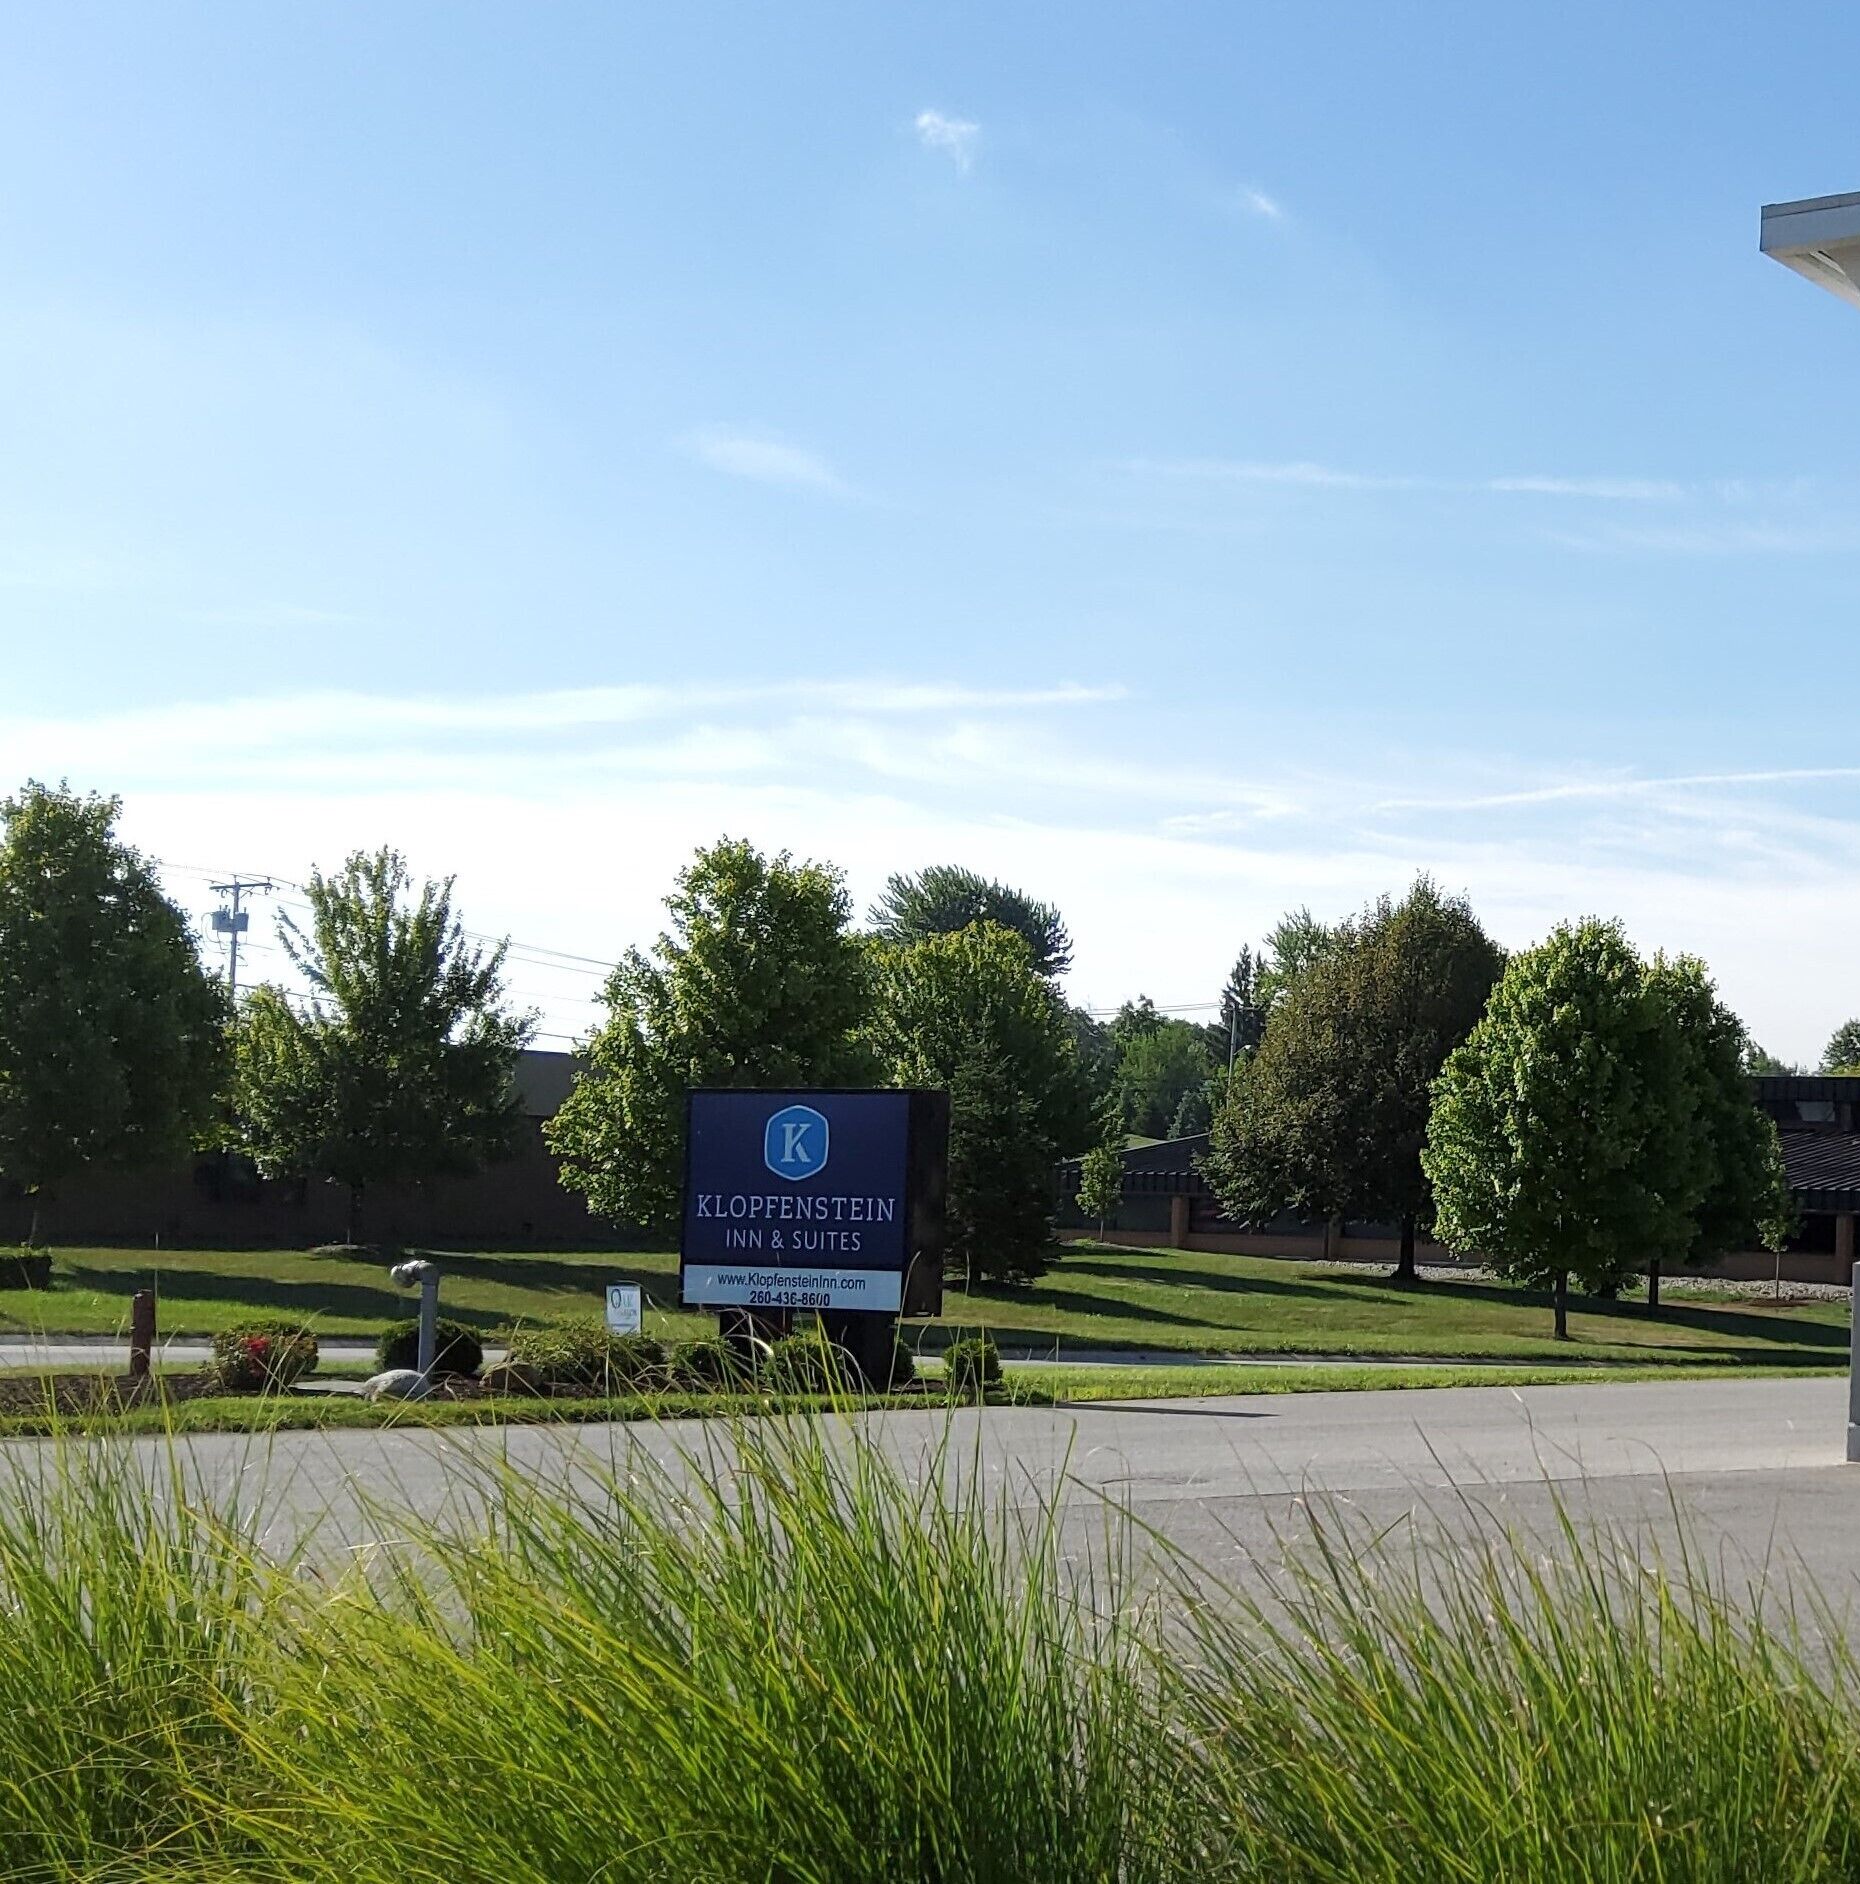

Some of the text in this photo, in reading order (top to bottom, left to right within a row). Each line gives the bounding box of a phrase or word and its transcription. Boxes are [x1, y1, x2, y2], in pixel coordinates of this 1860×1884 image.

[780, 1123, 812, 1163] K
[697, 1194, 895, 1221] KLOPFENSTEIN
[726, 1228, 861, 1252] INN & SUITES
[718, 1273, 866, 1290] www.KlopfensteinInn.com
